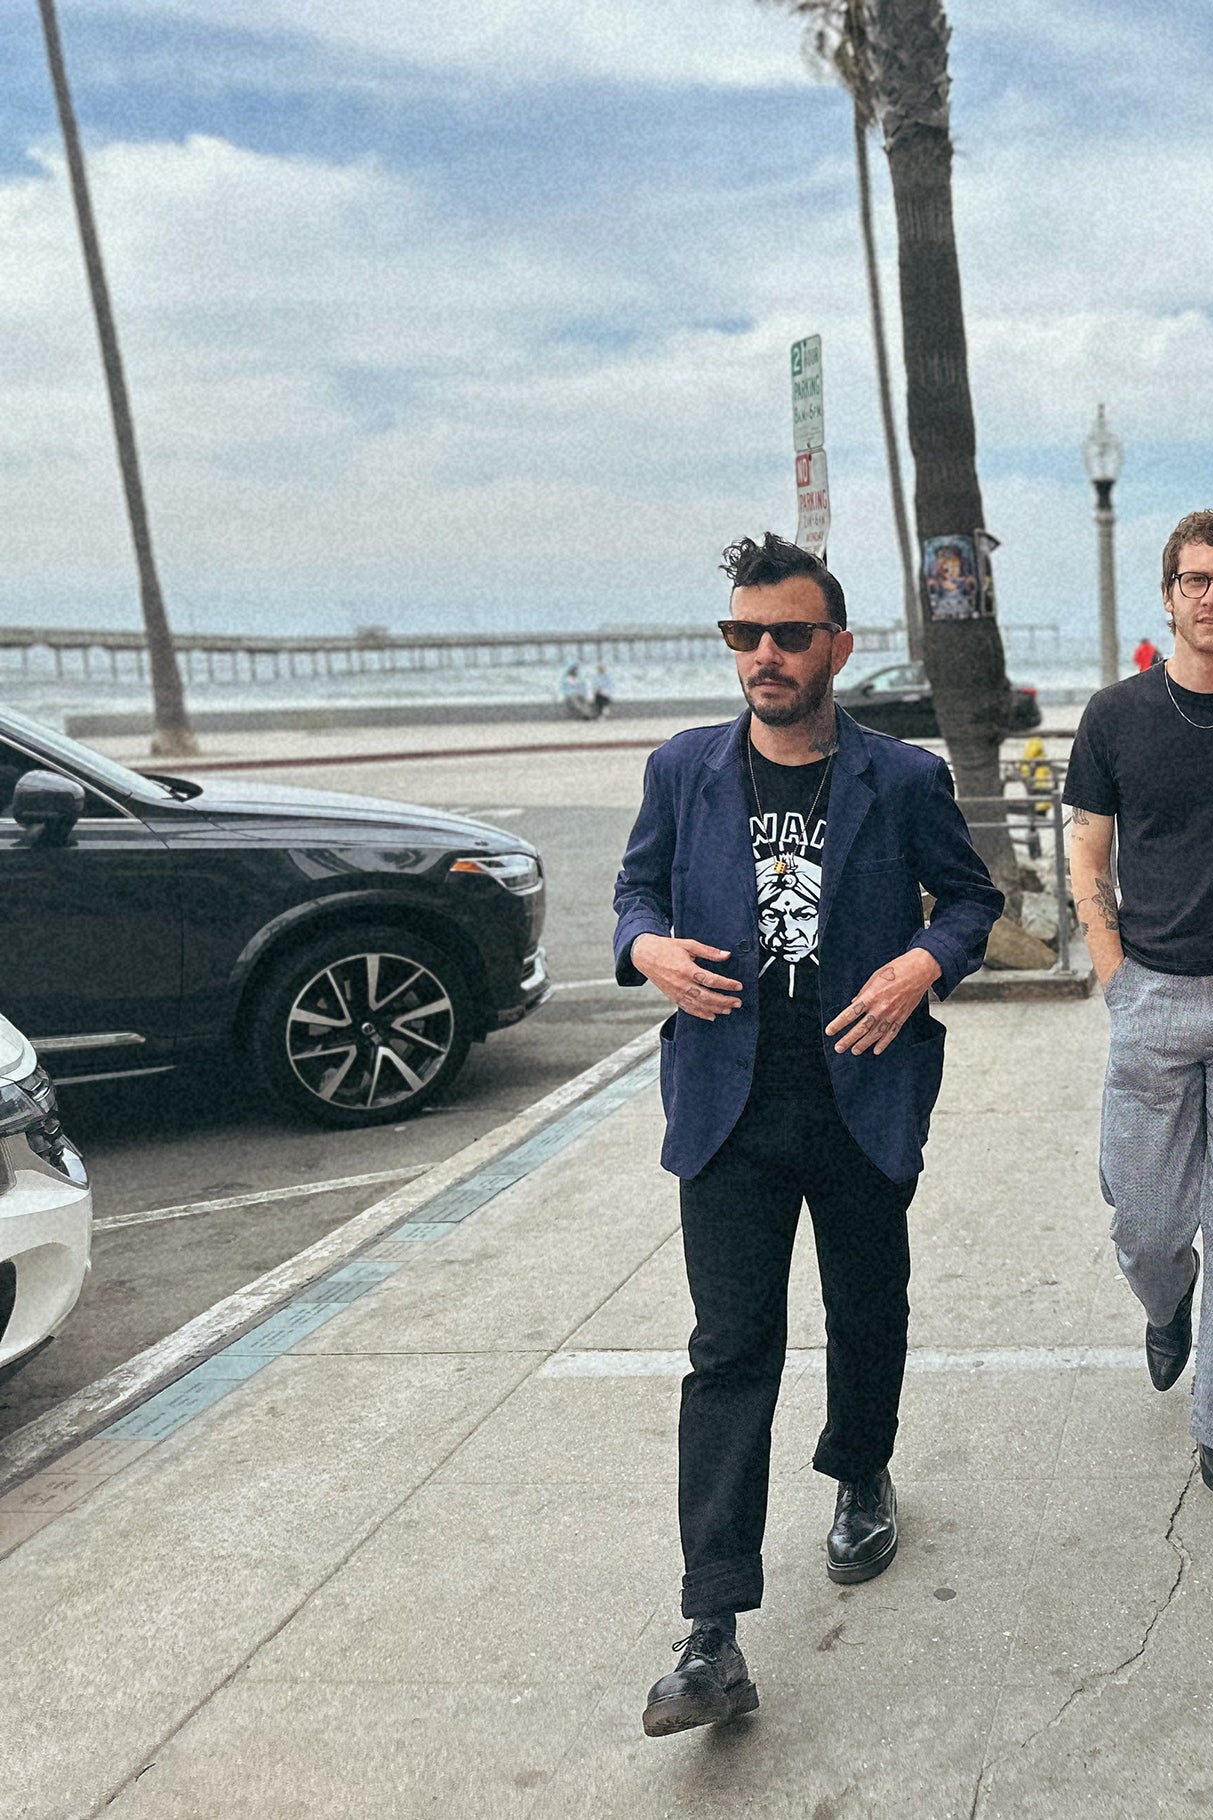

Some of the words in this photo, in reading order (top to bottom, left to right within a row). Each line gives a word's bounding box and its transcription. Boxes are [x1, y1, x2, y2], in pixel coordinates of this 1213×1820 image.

[792, 347, 801, 372] 2
[793, 375, 821, 401] PARKING
[797, 457, 809, 484] NO
[799, 488, 828, 513] PARKING
